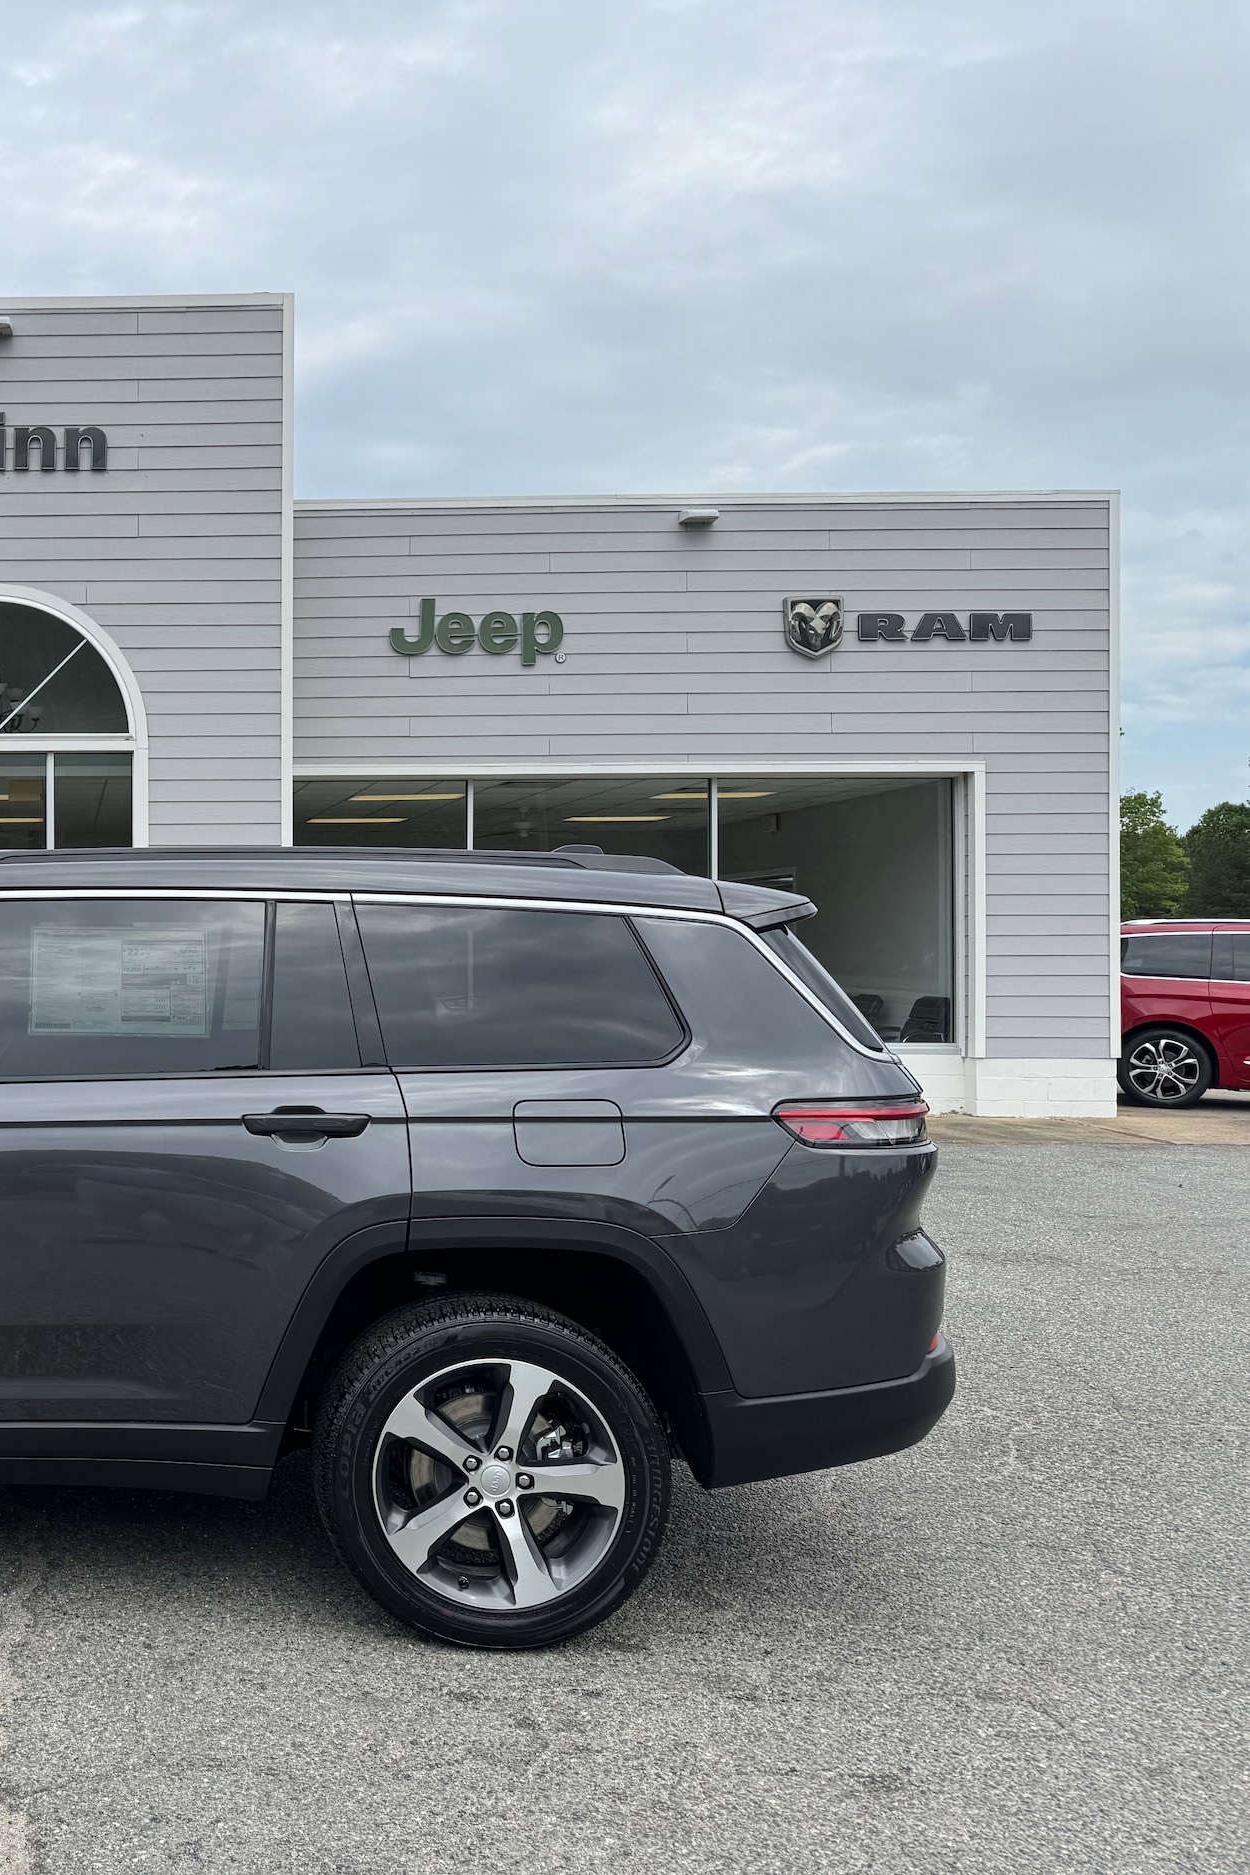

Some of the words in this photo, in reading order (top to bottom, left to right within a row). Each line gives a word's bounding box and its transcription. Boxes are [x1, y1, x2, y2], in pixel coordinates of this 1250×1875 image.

[390, 598, 564, 667] Jeep
[857, 611, 1033, 642] RAM
[490, 1469, 503, 1492] Jeep
